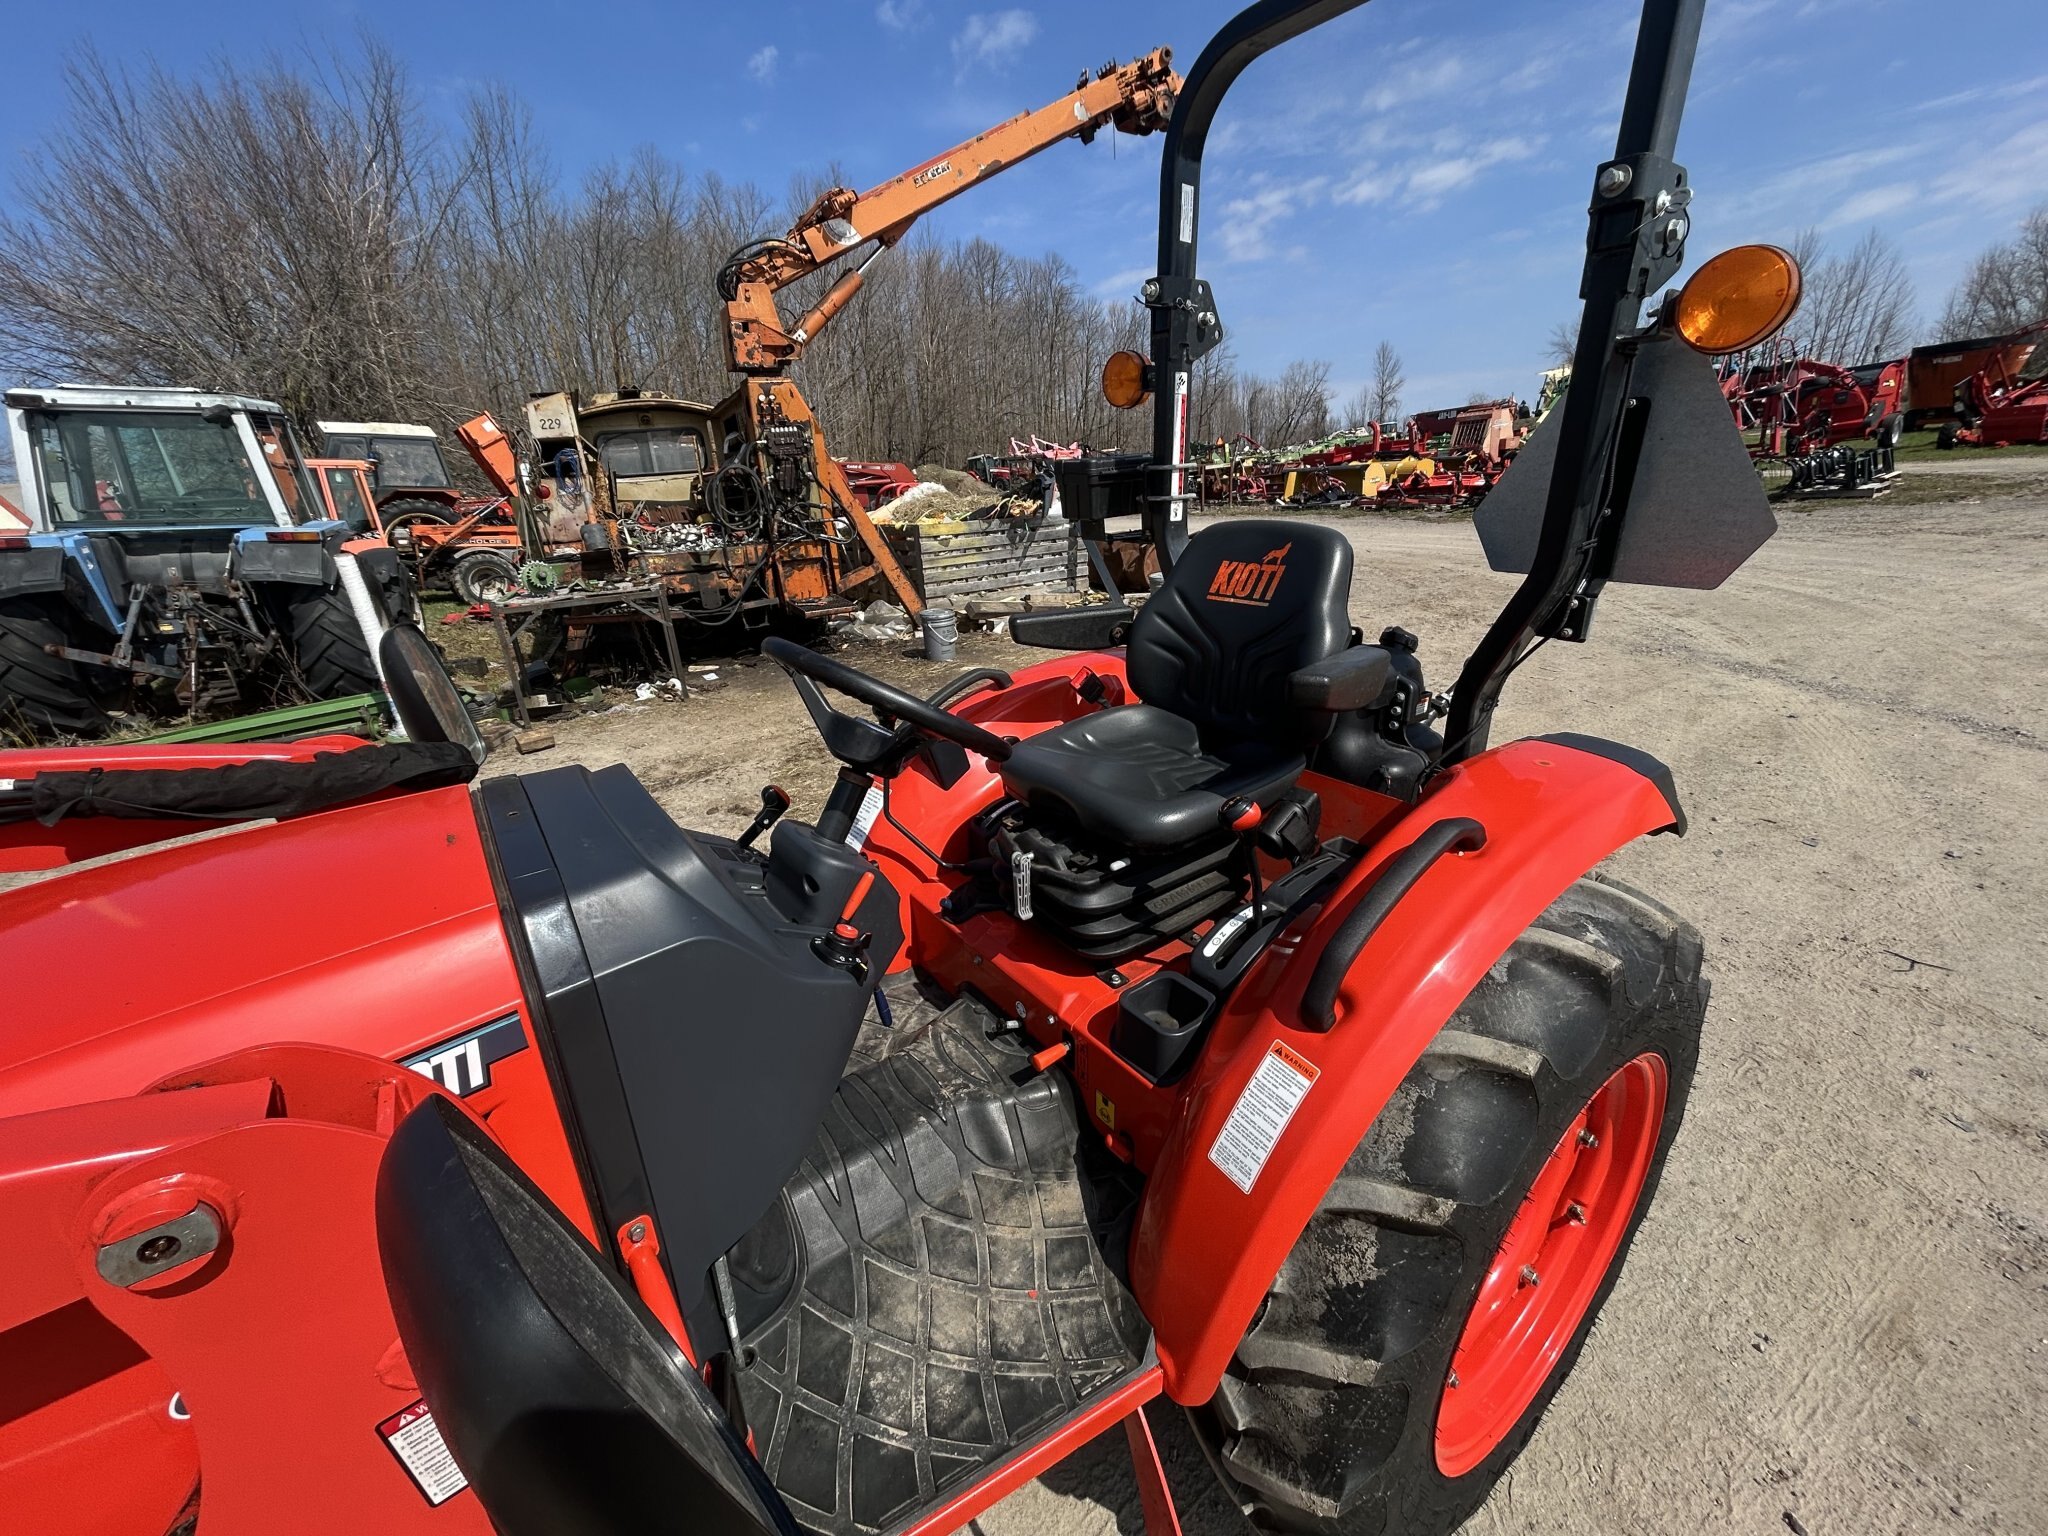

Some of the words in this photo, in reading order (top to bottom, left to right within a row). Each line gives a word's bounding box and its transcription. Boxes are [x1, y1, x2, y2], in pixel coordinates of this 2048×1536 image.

[539, 418, 561, 430] 229
[1208, 560, 1286, 600] KIOTI
[1283, 1052, 1314, 1079] WARNING
